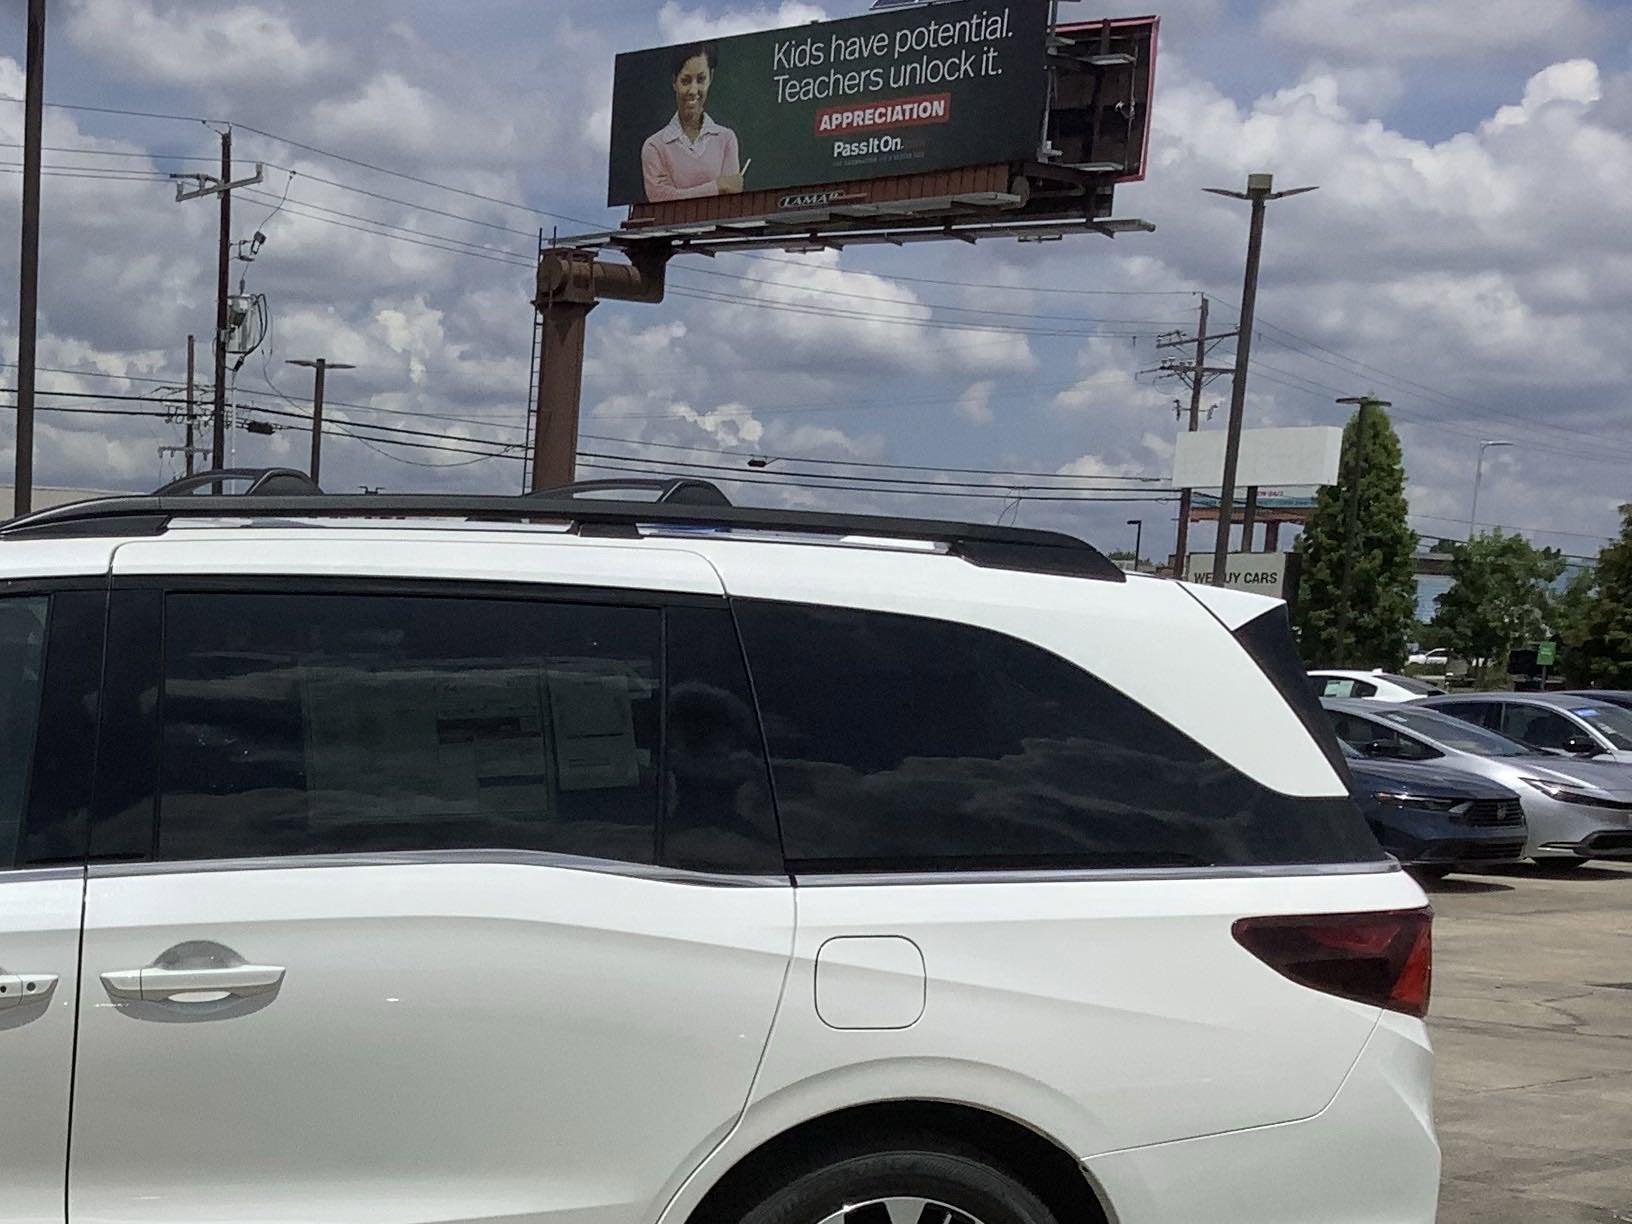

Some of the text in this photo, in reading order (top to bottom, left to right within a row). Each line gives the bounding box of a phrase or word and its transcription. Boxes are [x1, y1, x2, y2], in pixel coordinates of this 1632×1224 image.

[773, 8, 1013, 70] Kids have potential.
[774, 47, 1003, 103] Teachers unlock it.
[818, 100, 946, 131] APPRECIATION
[1244, 572, 1278, 584] CARS
